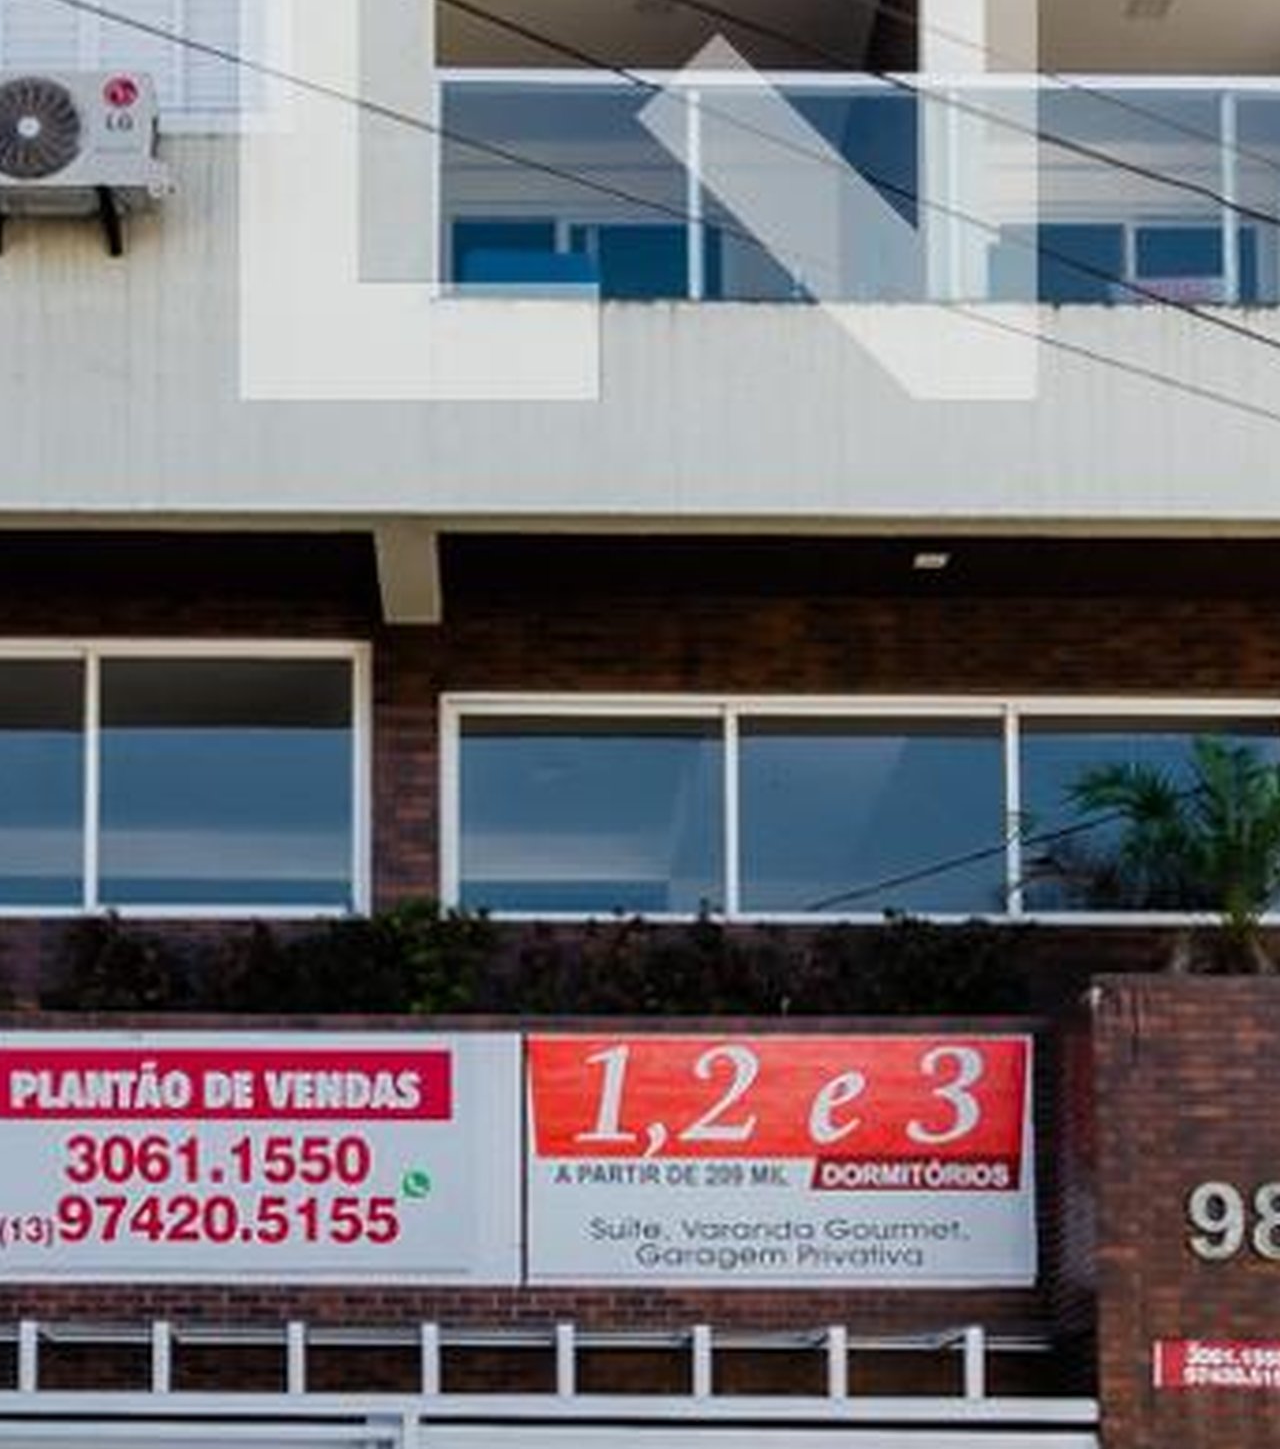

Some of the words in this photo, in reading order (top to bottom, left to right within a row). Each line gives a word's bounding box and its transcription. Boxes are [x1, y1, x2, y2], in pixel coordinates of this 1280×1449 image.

[9, 1061, 190, 1109] PLANTÃO
[203, 1071, 253, 1108] DE
[265, 1071, 421, 1109] VENDAS
[808, 1070, 866, 1144] e
[906, 1045, 985, 1144] 3
[64, 1135, 372, 1183] 3061.1550
[821, 1159, 1010, 1187] DORMITÓRIOS
[577, 1164, 661, 1184] PARTIR
[666, 1164, 699, 1185] DE
[680, 1219, 815, 1241] Varanda
[635, 1243, 787, 1270] Garagem
[797, 1243, 923, 1267] Privativa
